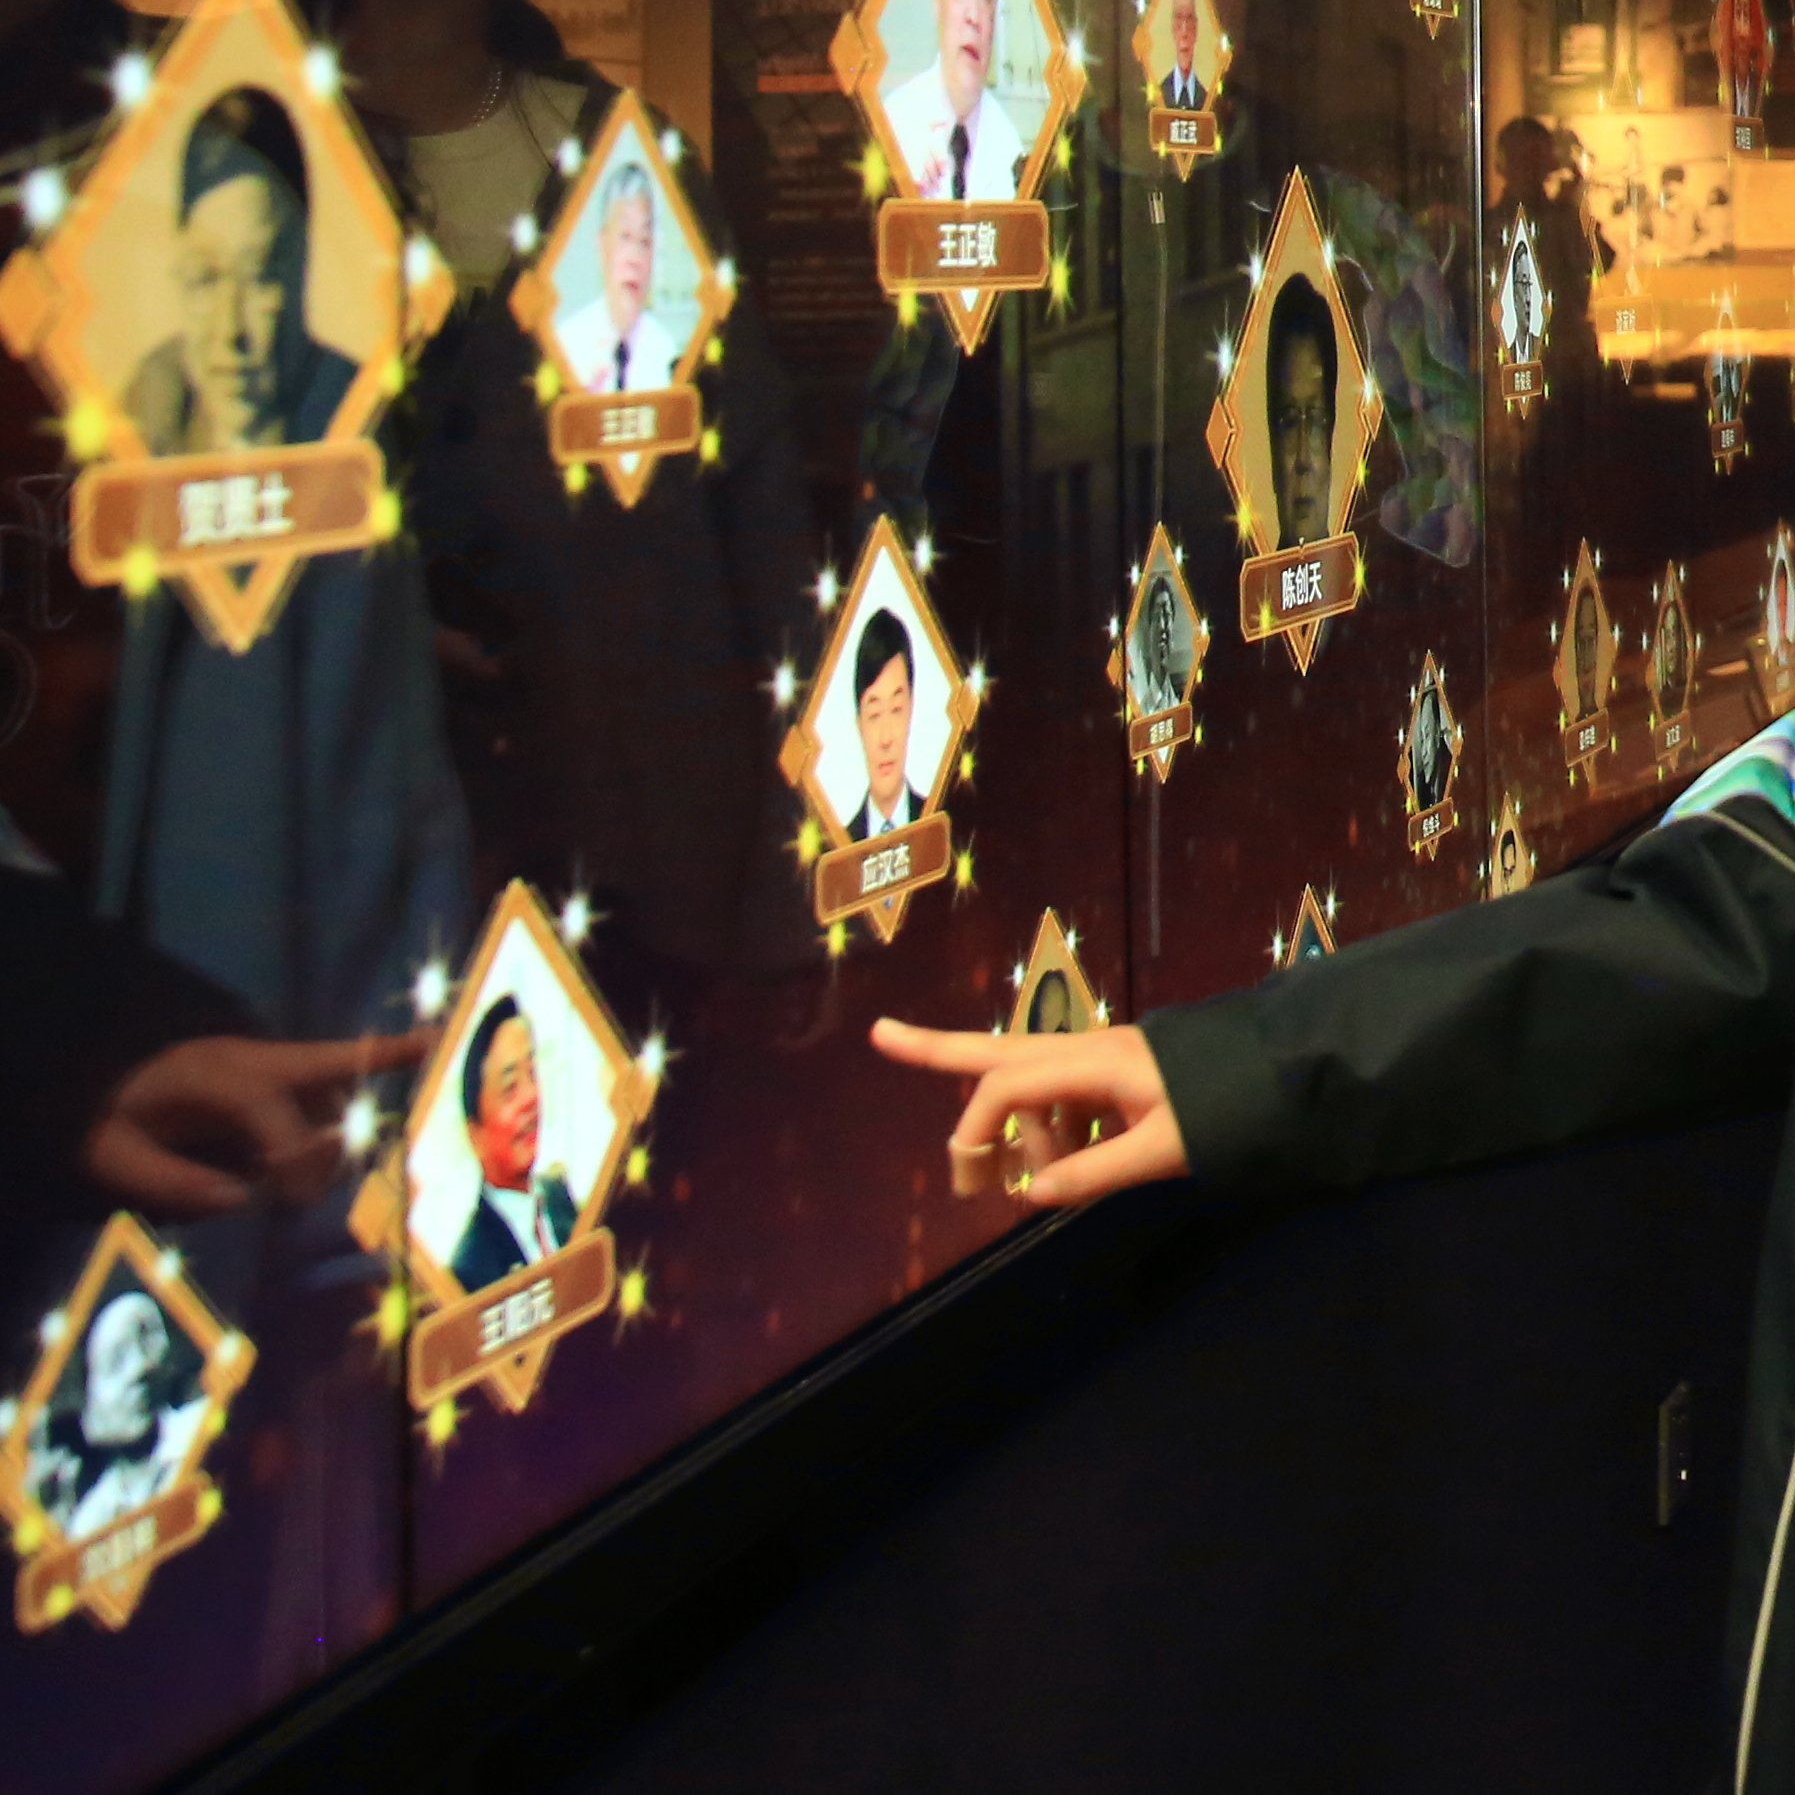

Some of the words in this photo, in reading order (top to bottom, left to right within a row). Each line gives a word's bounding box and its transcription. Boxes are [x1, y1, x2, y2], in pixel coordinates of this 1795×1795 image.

[938, 221, 998, 267] 王正敏
[1282, 561, 1323, 610] 陈创天
[861, 842, 912, 893] 应汉杰
